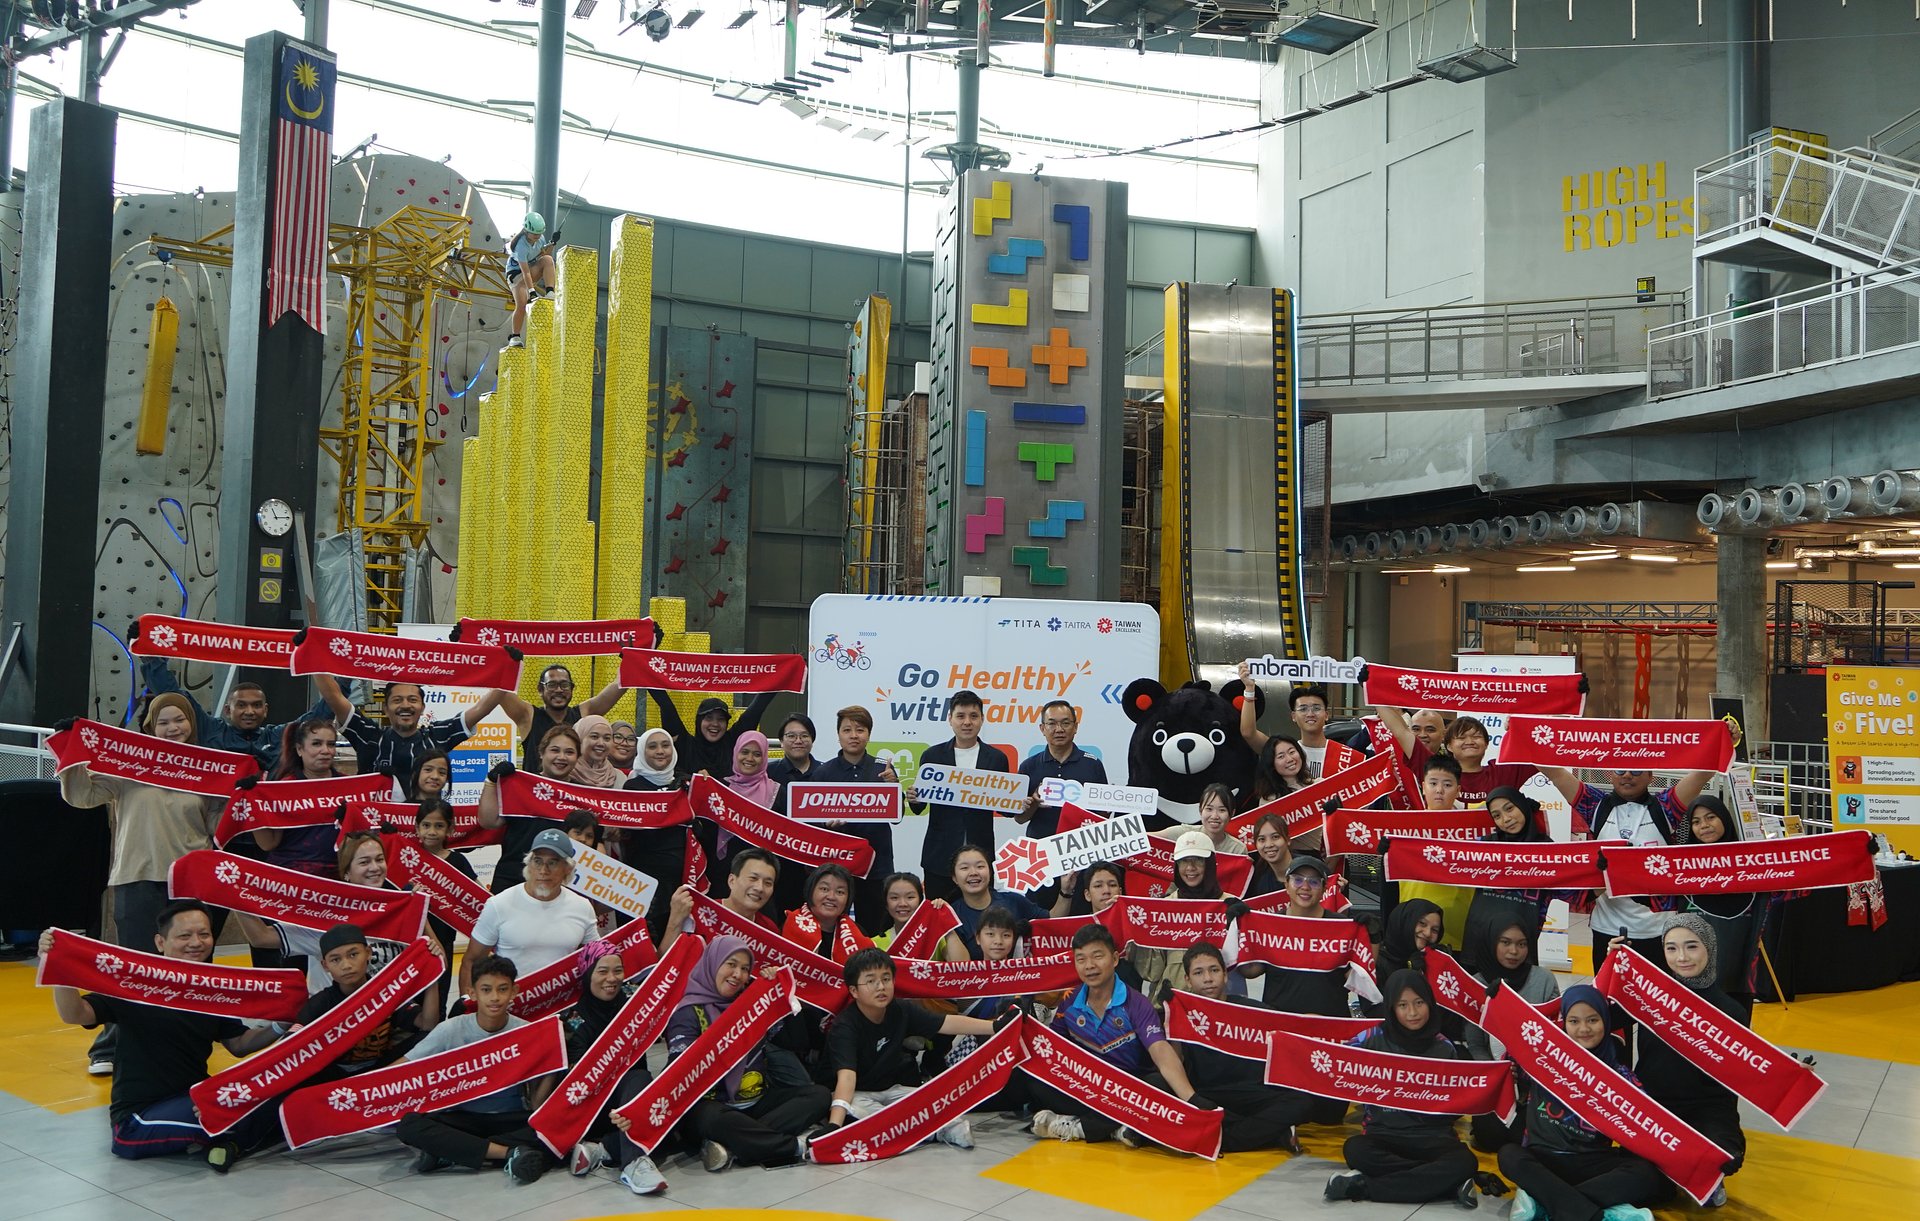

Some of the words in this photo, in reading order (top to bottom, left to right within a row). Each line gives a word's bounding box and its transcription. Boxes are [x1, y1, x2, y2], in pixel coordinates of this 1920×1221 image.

[1562, 161, 1666, 212] HIGH
[1563, 196, 1710, 252] ROPES
[182, 632, 243, 650] TAIWAN
[248, 640, 293, 654] EXCEL
[504, 632, 555, 644] TAIWAN
[559, 631, 636, 644] EXCELLENCE
[356, 644, 405, 660] TAIWAN
[409, 650, 486, 666] EXCELLENCE
[670, 662, 710, 673] TAIWAN
[713, 664, 776, 674] EXCELLENCE
[898, 663, 939, 688] Go
[947, 665, 1076, 696] Healthy
[1422, 678, 1469, 690] TAIWAN
[1472, 681, 1547, 693] EXCELLENCE
[1840, 691, 1874, 706] Give
[1878, 693, 1901, 706] Me
[1856, 711, 1914, 735] Five!
[1558, 731, 1612, 744] TAIWAN
[1613, 732, 1700, 745] EXCELLENCE
[102, 738, 154, 760] TAIWAN
[156, 752, 236, 774] EXCELLENCE
[920, 767, 944, 783] Go
[948, 771, 1022, 794] Healthy
[255, 798, 314, 812] TAIWAN
[600, 800, 668, 812] EXCELLENCE
[799, 793, 890, 809] JOHNSON
[914, 788, 954, 802] with
[959, 790, 1023, 811] Taiwan
[1089, 787, 1154, 804] BioGend
[1539, 800, 1562, 811] Get!
[727, 807, 774, 840] TAIWAN
[775, 834, 854, 861] EXCELLENCE
[1051, 815, 1143, 856] TAIWAN
[1061, 838, 1147, 872] EXCELLENCE
[1449, 850, 1501, 864] TAIWAN
[1505, 852, 1590, 863] EXCELLENCE
[1674, 852, 1735, 869] TAIWAN
[1736, 848, 1831, 867] EXCELLENCE
[420, 862, 464, 899] TAIWAN
[578, 849, 649, 894] Healthy
[244, 872, 299, 902] TAIWAN
[301, 887, 388, 912] EXCELLENCE
[582, 880, 646, 915] Taiwan
[1151, 912, 1202, 924] TAIWAN
[720, 921, 767, 954] TAIWAN
[767, 948, 846, 988] EXCELLENCE
[1248, 930, 1304, 951] TAIWAN
[128, 962, 188, 986] TAIWAN
[190, 973, 282, 993] EXCELLENCE
[935, 960, 990, 973] TAIWAN
[990, 955, 1072, 970] EXCELLENCE
[517, 972, 571, 1004] TAIWAN
[937, 976, 989, 990] Everyday
[992, 971, 1041, 983] Excellence
[250, 1038, 324, 1089] TAIWAN
[326, 963, 420, 1044] EXCELLENCE
[584, 1035, 625, 1084] TAIWAN
[622, 965, 681, 1037] EXCELLENCE
[1630, 967, 1680, 1012] TAIWAN
[1679, 1005, 1773, 1074] EXCELLENCE
[669, 1050, 716, 1101] TAIWAN
[716, 982, 786, 1053] EXCELLENCE
[361, 1074, 424, 1102] TAIWAN
[426, 1043, 521, 1082] EXCELLENCE
[1336, 1060, 1393, 1081] TAIWAN
[1396, 1069, 1488, 1088] EXCELLENCE
[870, 1106, 930, 1148] TAIWAN
[933, 1045, 1016, 1114] EXCELLENCE
[1055, 1050, 1103, 1085] TAIWAN
[1104, 1079, 1186, 1126] EXCELLENCE
[1544, 1040, 1596, 1085] TAIWAN
[1594, 1080, 1682, 1152] EXCELLENCE
